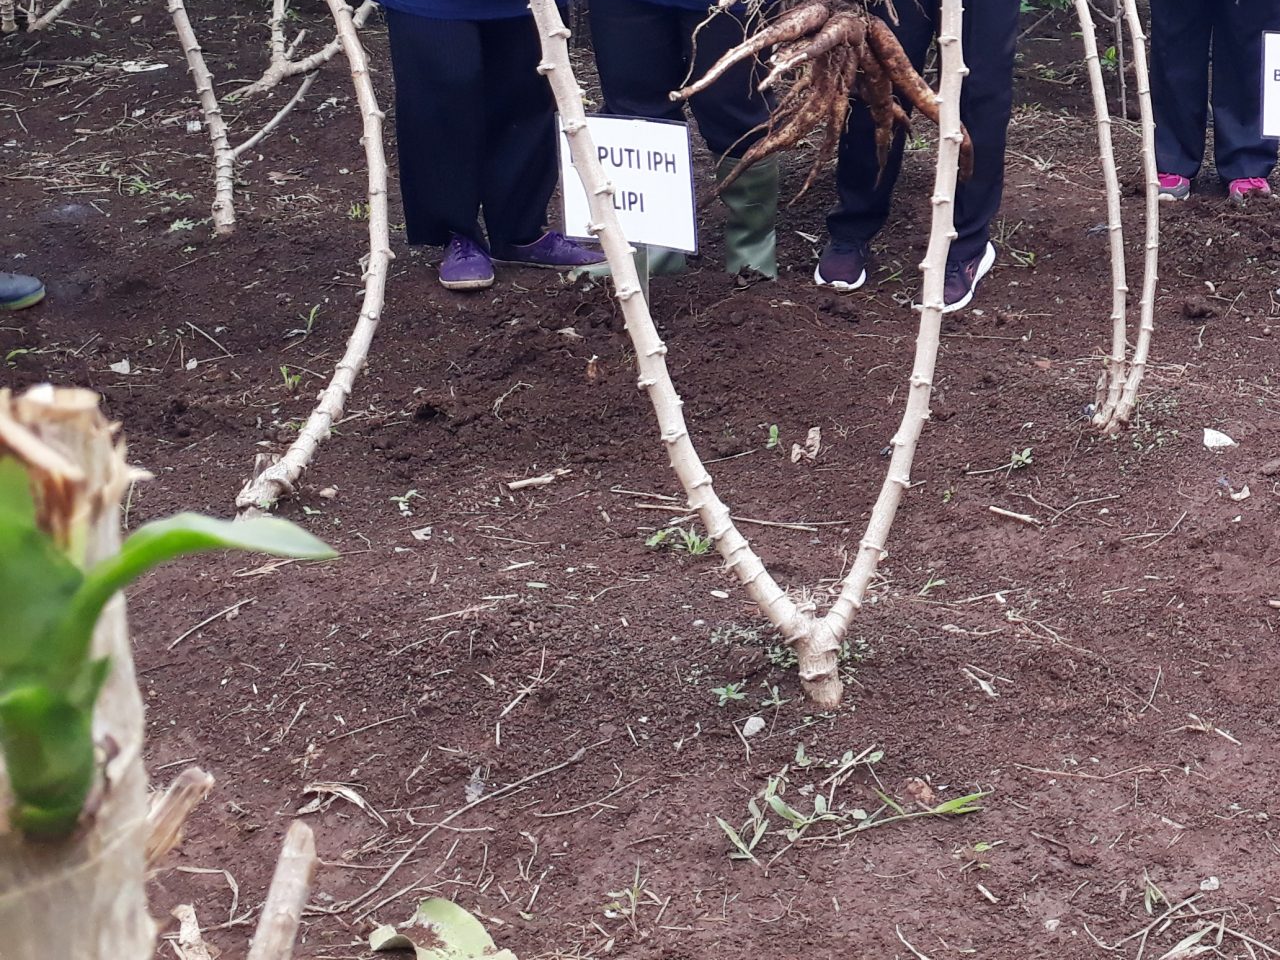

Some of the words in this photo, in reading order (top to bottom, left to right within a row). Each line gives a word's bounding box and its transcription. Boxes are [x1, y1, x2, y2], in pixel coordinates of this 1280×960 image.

[570, 145, 641, 169] PUTI
[647, 150, 677, 174] IPH
[612, 190, 645, 213] LIPI
